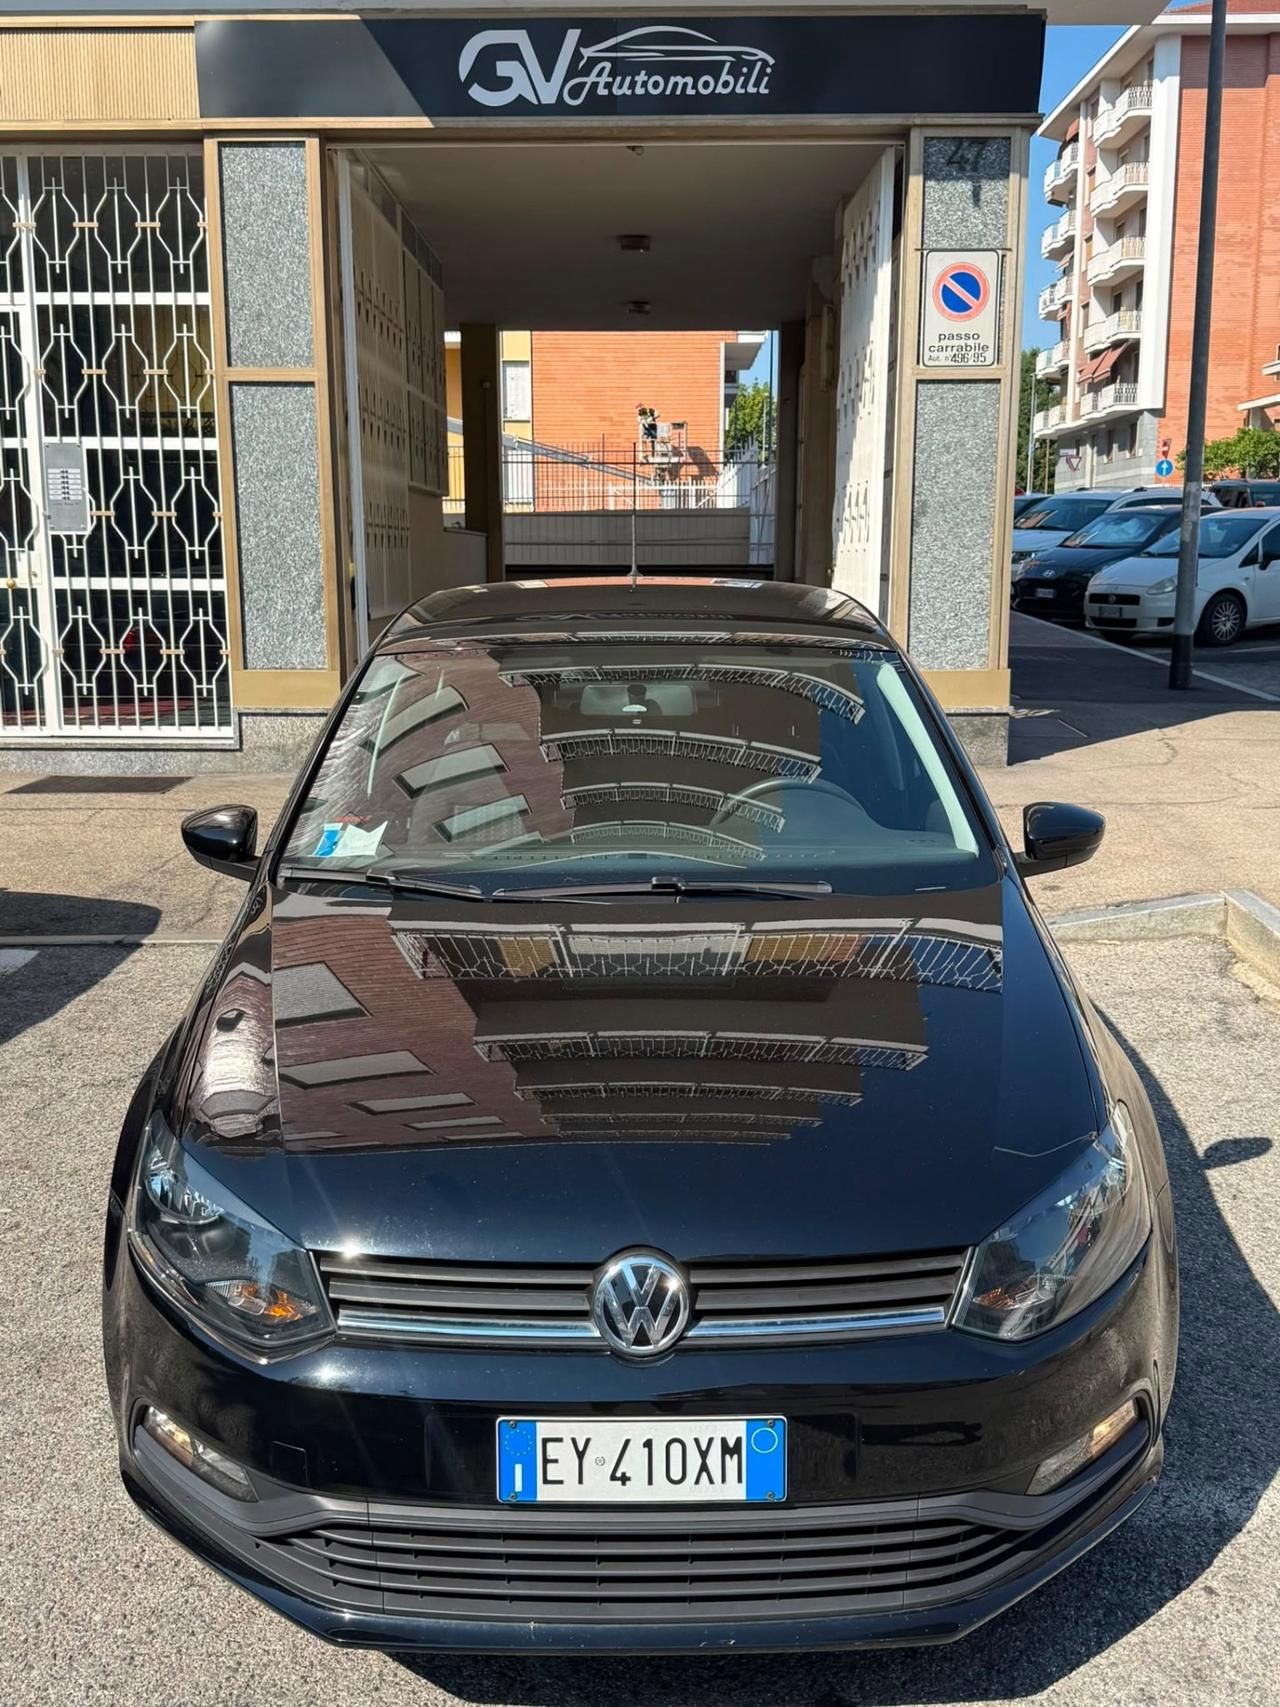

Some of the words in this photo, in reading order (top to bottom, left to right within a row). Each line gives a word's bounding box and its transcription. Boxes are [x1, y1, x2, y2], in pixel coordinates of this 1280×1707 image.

[458, 29, 582, 107] GV
[563, 61, 771, 106] Automobili
[928, 343, 989, 353] carrabile
[938, 333, 980, 343] passo
[541, 1436, 592, 1485] EY
[609, 1436, 743, 1486] 410XM
